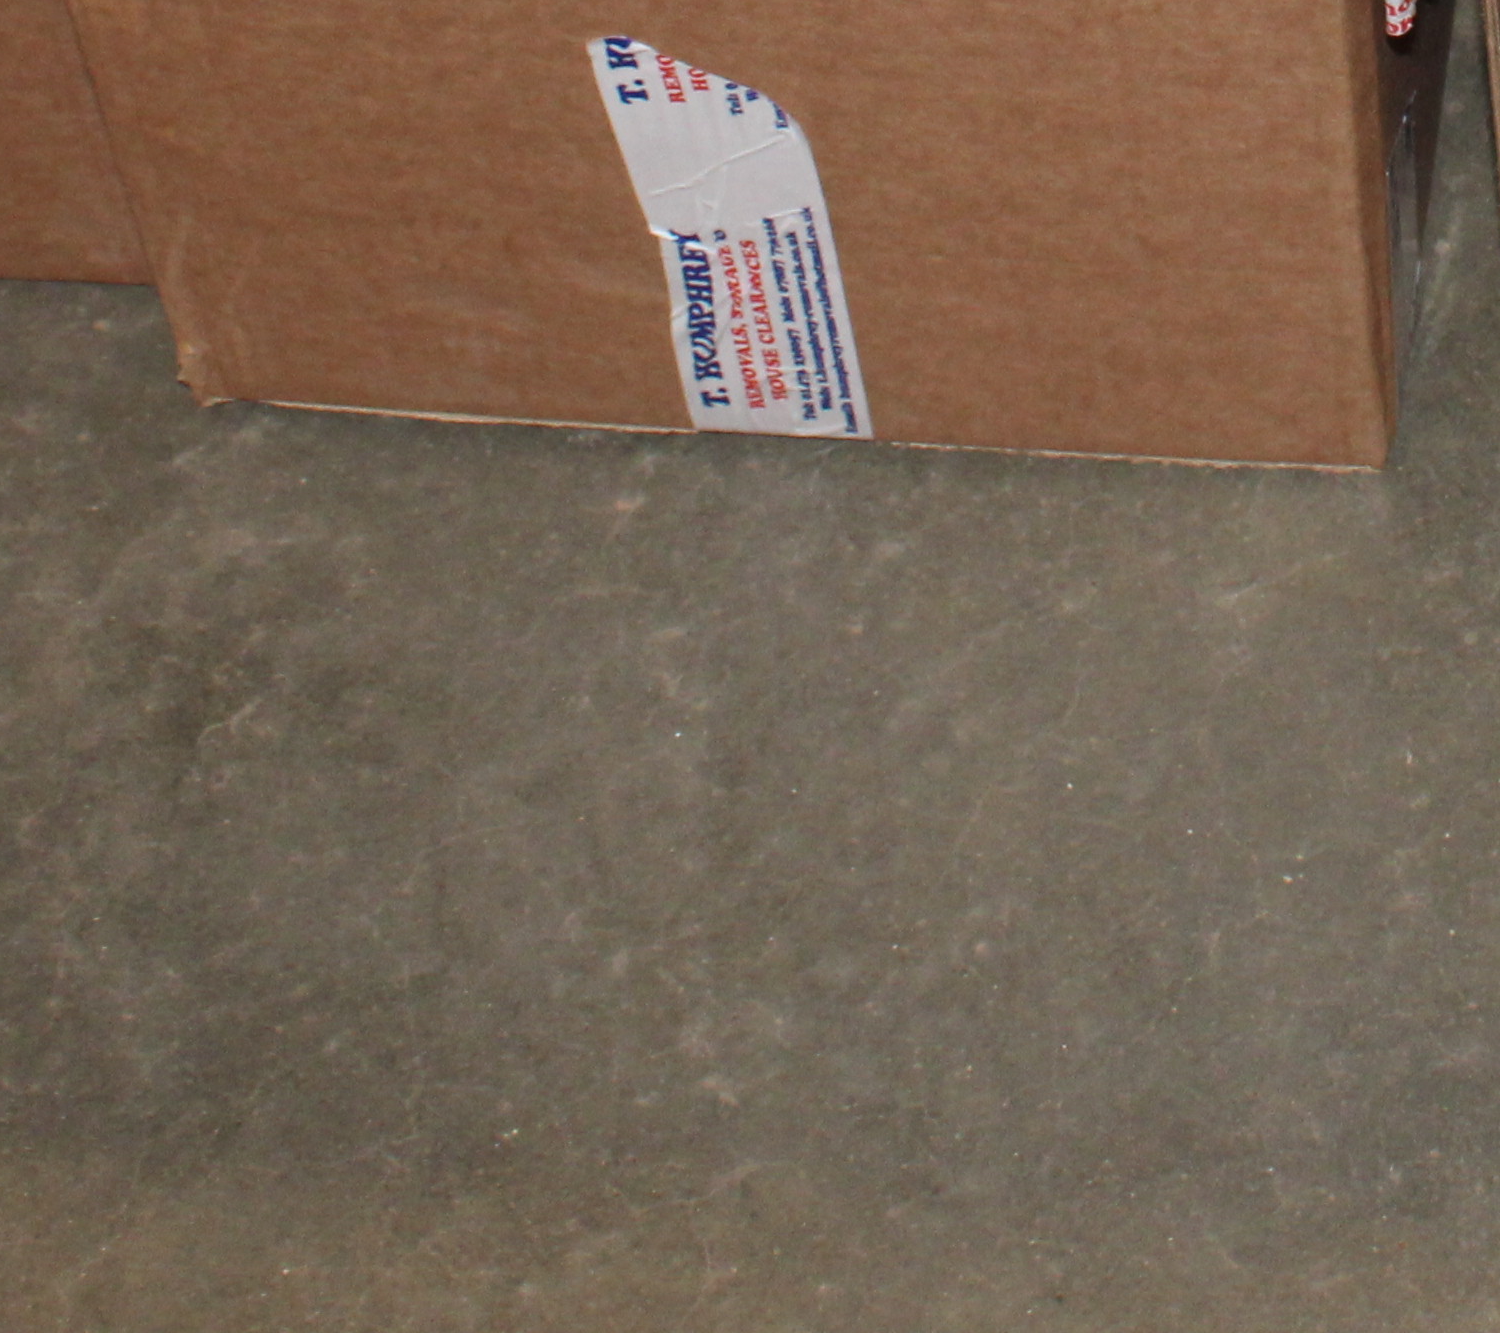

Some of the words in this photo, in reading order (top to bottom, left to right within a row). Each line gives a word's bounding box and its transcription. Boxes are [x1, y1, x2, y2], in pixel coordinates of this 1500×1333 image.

[617, 78, 649, 104] T.
[669, 228, 716, 380] HUMPHREY
[731, 322, 766, 410] REMOVALS,
[764, 345, 789, 400] HOUSE
[701, 387, 730, 408] T.
